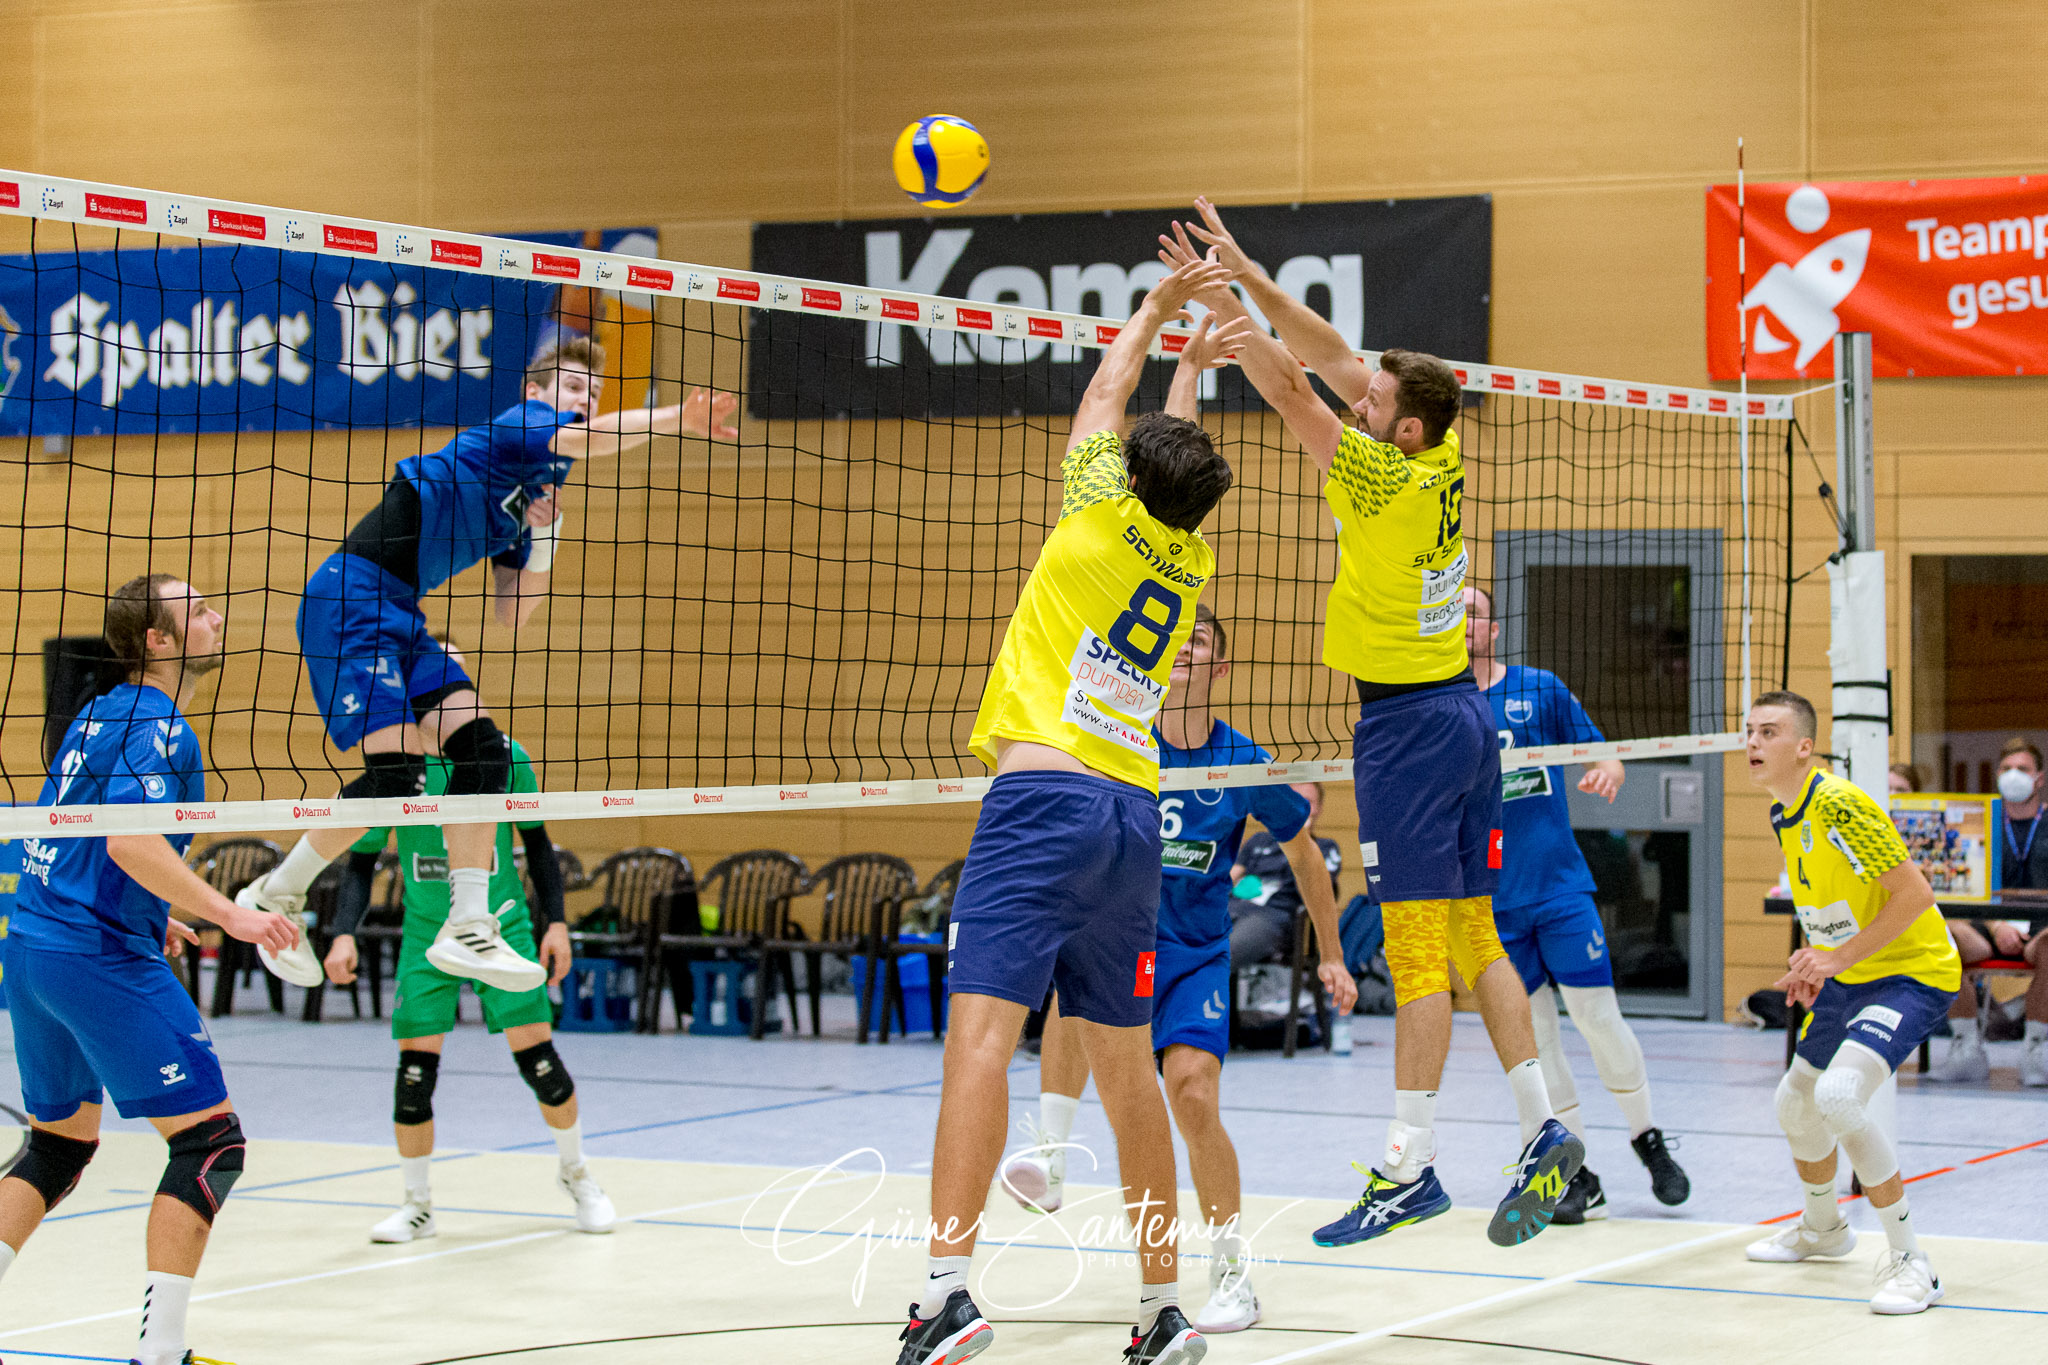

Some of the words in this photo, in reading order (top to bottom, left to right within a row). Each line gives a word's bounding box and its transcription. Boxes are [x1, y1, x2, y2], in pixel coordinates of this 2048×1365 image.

[49, 199, 63, 208] Zapf
[99, 205, 121, 215] Sparkasse
[122, 208, 143, 219] Nürnberg
[174, 216, 188, 225] Zapf
[220, 221, 242, 231] Sparkasse
[242, 223, 262, 235] Nürnberg
[291, 231, 305, 240] Zapf
[335, 236, 355, 246] Sparkasse
[355, 239, 374, 249] Nürnberg
[401, 245, 413, 254] Zapf
[442, 250, 461, 260] Sparkasse
[461, 253, 479, 263] Nürnberg
[543, 264, 560, 272] Sparkasse
[601, 271, 612, 279] Zapf
[44, 292, 311, 410] Spalter
[332, 280, 494, 384] Bier
[1412, 551, 1436, 568] SV
[1108, 579, 1182, 671] 8
[1075, 661, 1145, 711] pumpen
[866, 787, 888, 796] Marmot
[942, 784, 963, 793] Marmot
[699, 793, 723, 803] Marmot
[785, 790, 808, 800] Marmot
[514, 800, 539, 810] Marmot
[610, 796, 634, 807] Marmot
[301, 807, 331, 818] Marmot
[411, 803, 439, 814] Marmot
[59, 813, 93, 824] Marmot
[185, 810, 216, 820] Marmot
[1861, 1022, 1892, 1043] Kempa
